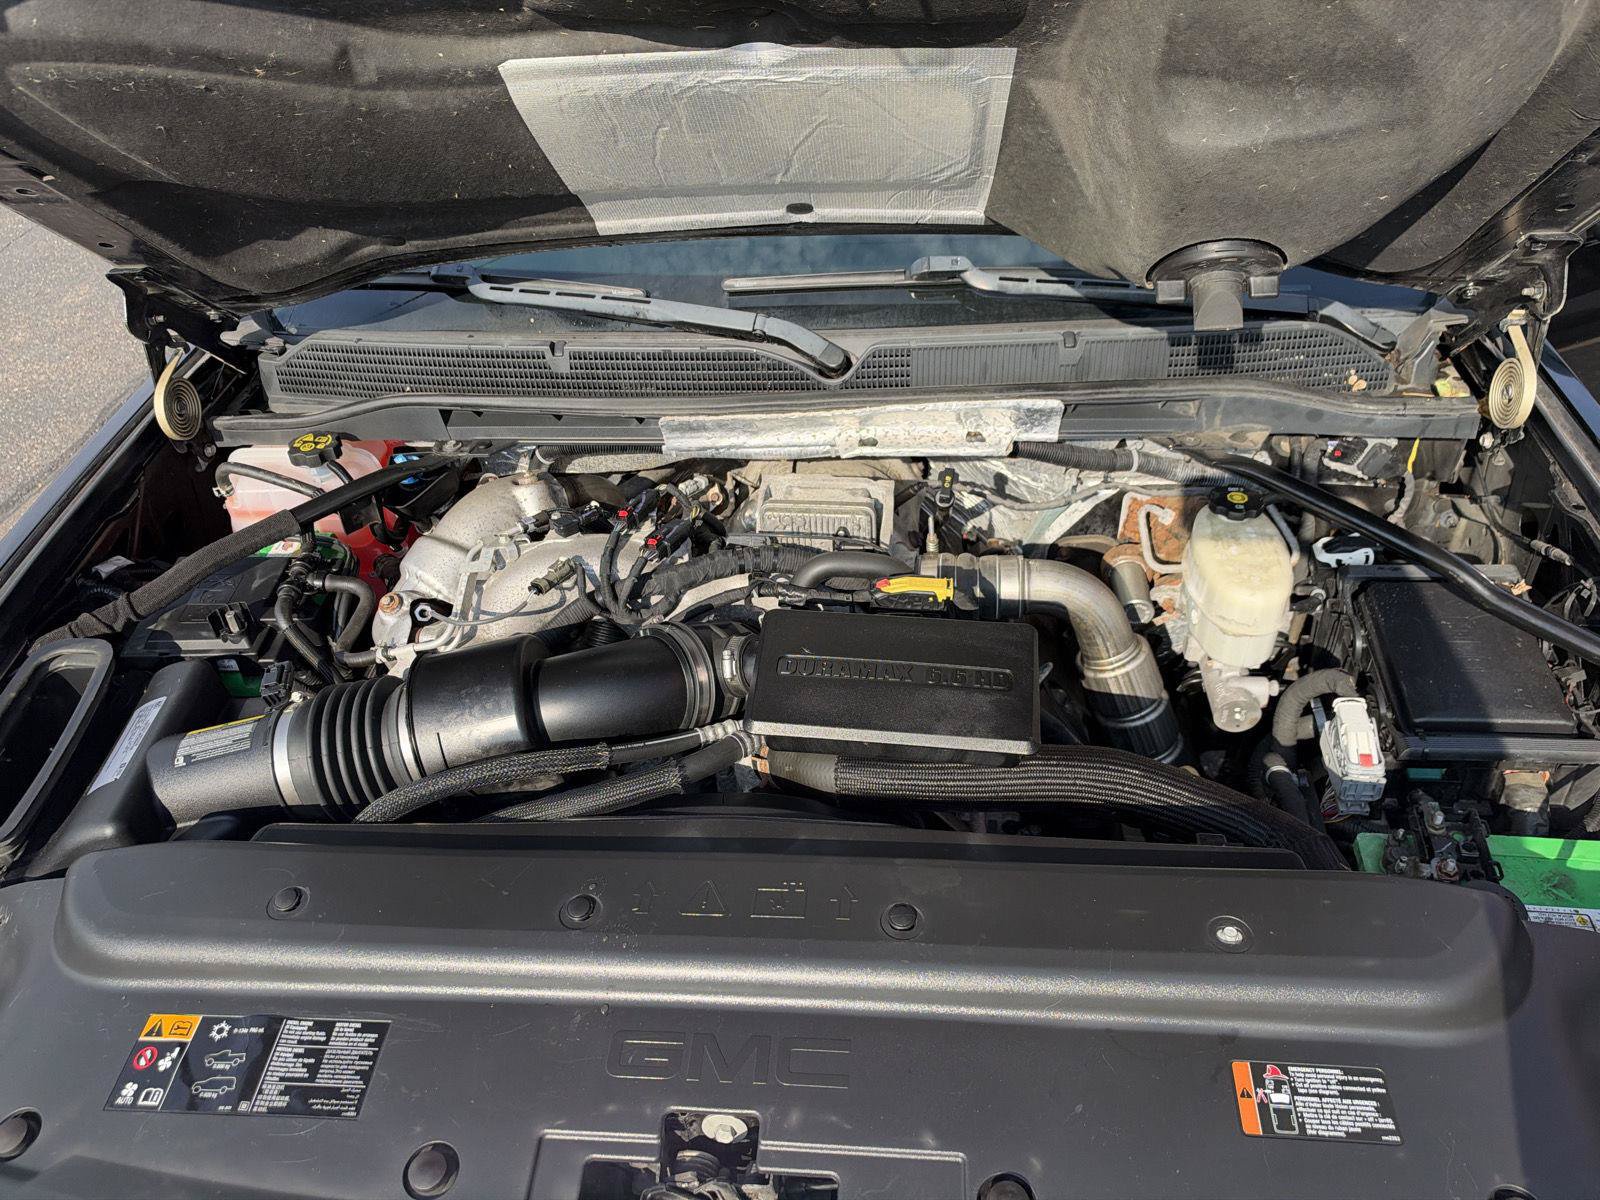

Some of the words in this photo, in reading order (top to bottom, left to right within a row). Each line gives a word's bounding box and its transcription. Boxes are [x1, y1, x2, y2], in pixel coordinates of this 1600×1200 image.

[780, 658, 914, 682] DURAMAX
[604, 1030, 851, 1089] GMC
[115, 1096, 134, 1105] AUTO
